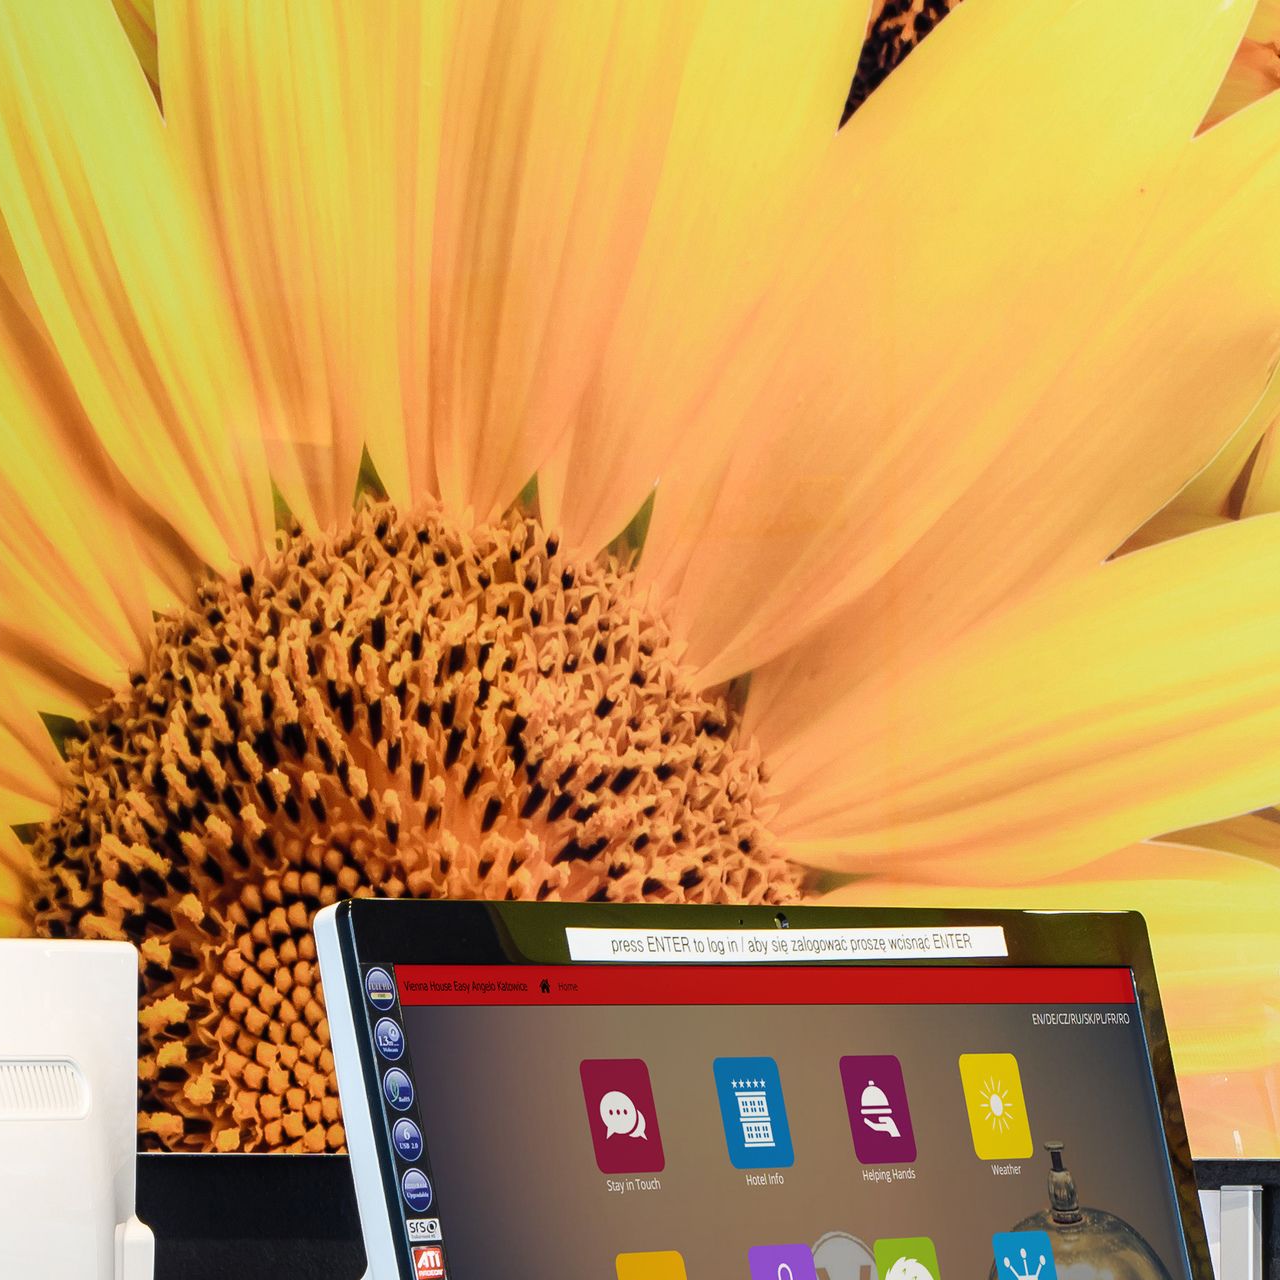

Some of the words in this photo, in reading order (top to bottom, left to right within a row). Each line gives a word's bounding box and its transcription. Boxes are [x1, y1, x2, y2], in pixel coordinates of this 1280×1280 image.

[611, 937, 645, 954] press
[647, 936, 691, 953] ENTER
[693, 937, 705, 953] to
[707, 936, 725, 955] log
[727, 936, 738, 952] in
[748, 937, 768, 955] aby
[771, 936, 788, 955] się
[791, 935, 847, 954] zalogować
[851, 936, 887, 953] proszę
[888, 934, 931, 951] wcisnąć
[932, 933, 973, 950] ENTER
[403, 981, 428, 992] Vienna
[430, 980, 452, 992] House
[453, 980, 470, 994] Easy
[471, 980, 496, 994] Angelo
[497, 980, 528, 992] Katowice
[558, 982, 578, 992] Home
[403, 1127, 411, 1141] 6
[399, 1142, 410, 1150] USB
[862, 1169, 892, 1183] Helping
[892, 1167, 916, 1180] Hands
[991, 1163, 1022, 1176] Weather
[606, 1179, 625, 1195] Stay
[625, 1178, 635, 1191] in
[635, 1177, 661, 1191] Touch
[745, 1173, 768, 1187] Hotel
[768, 1172, 785, 1185] Info
